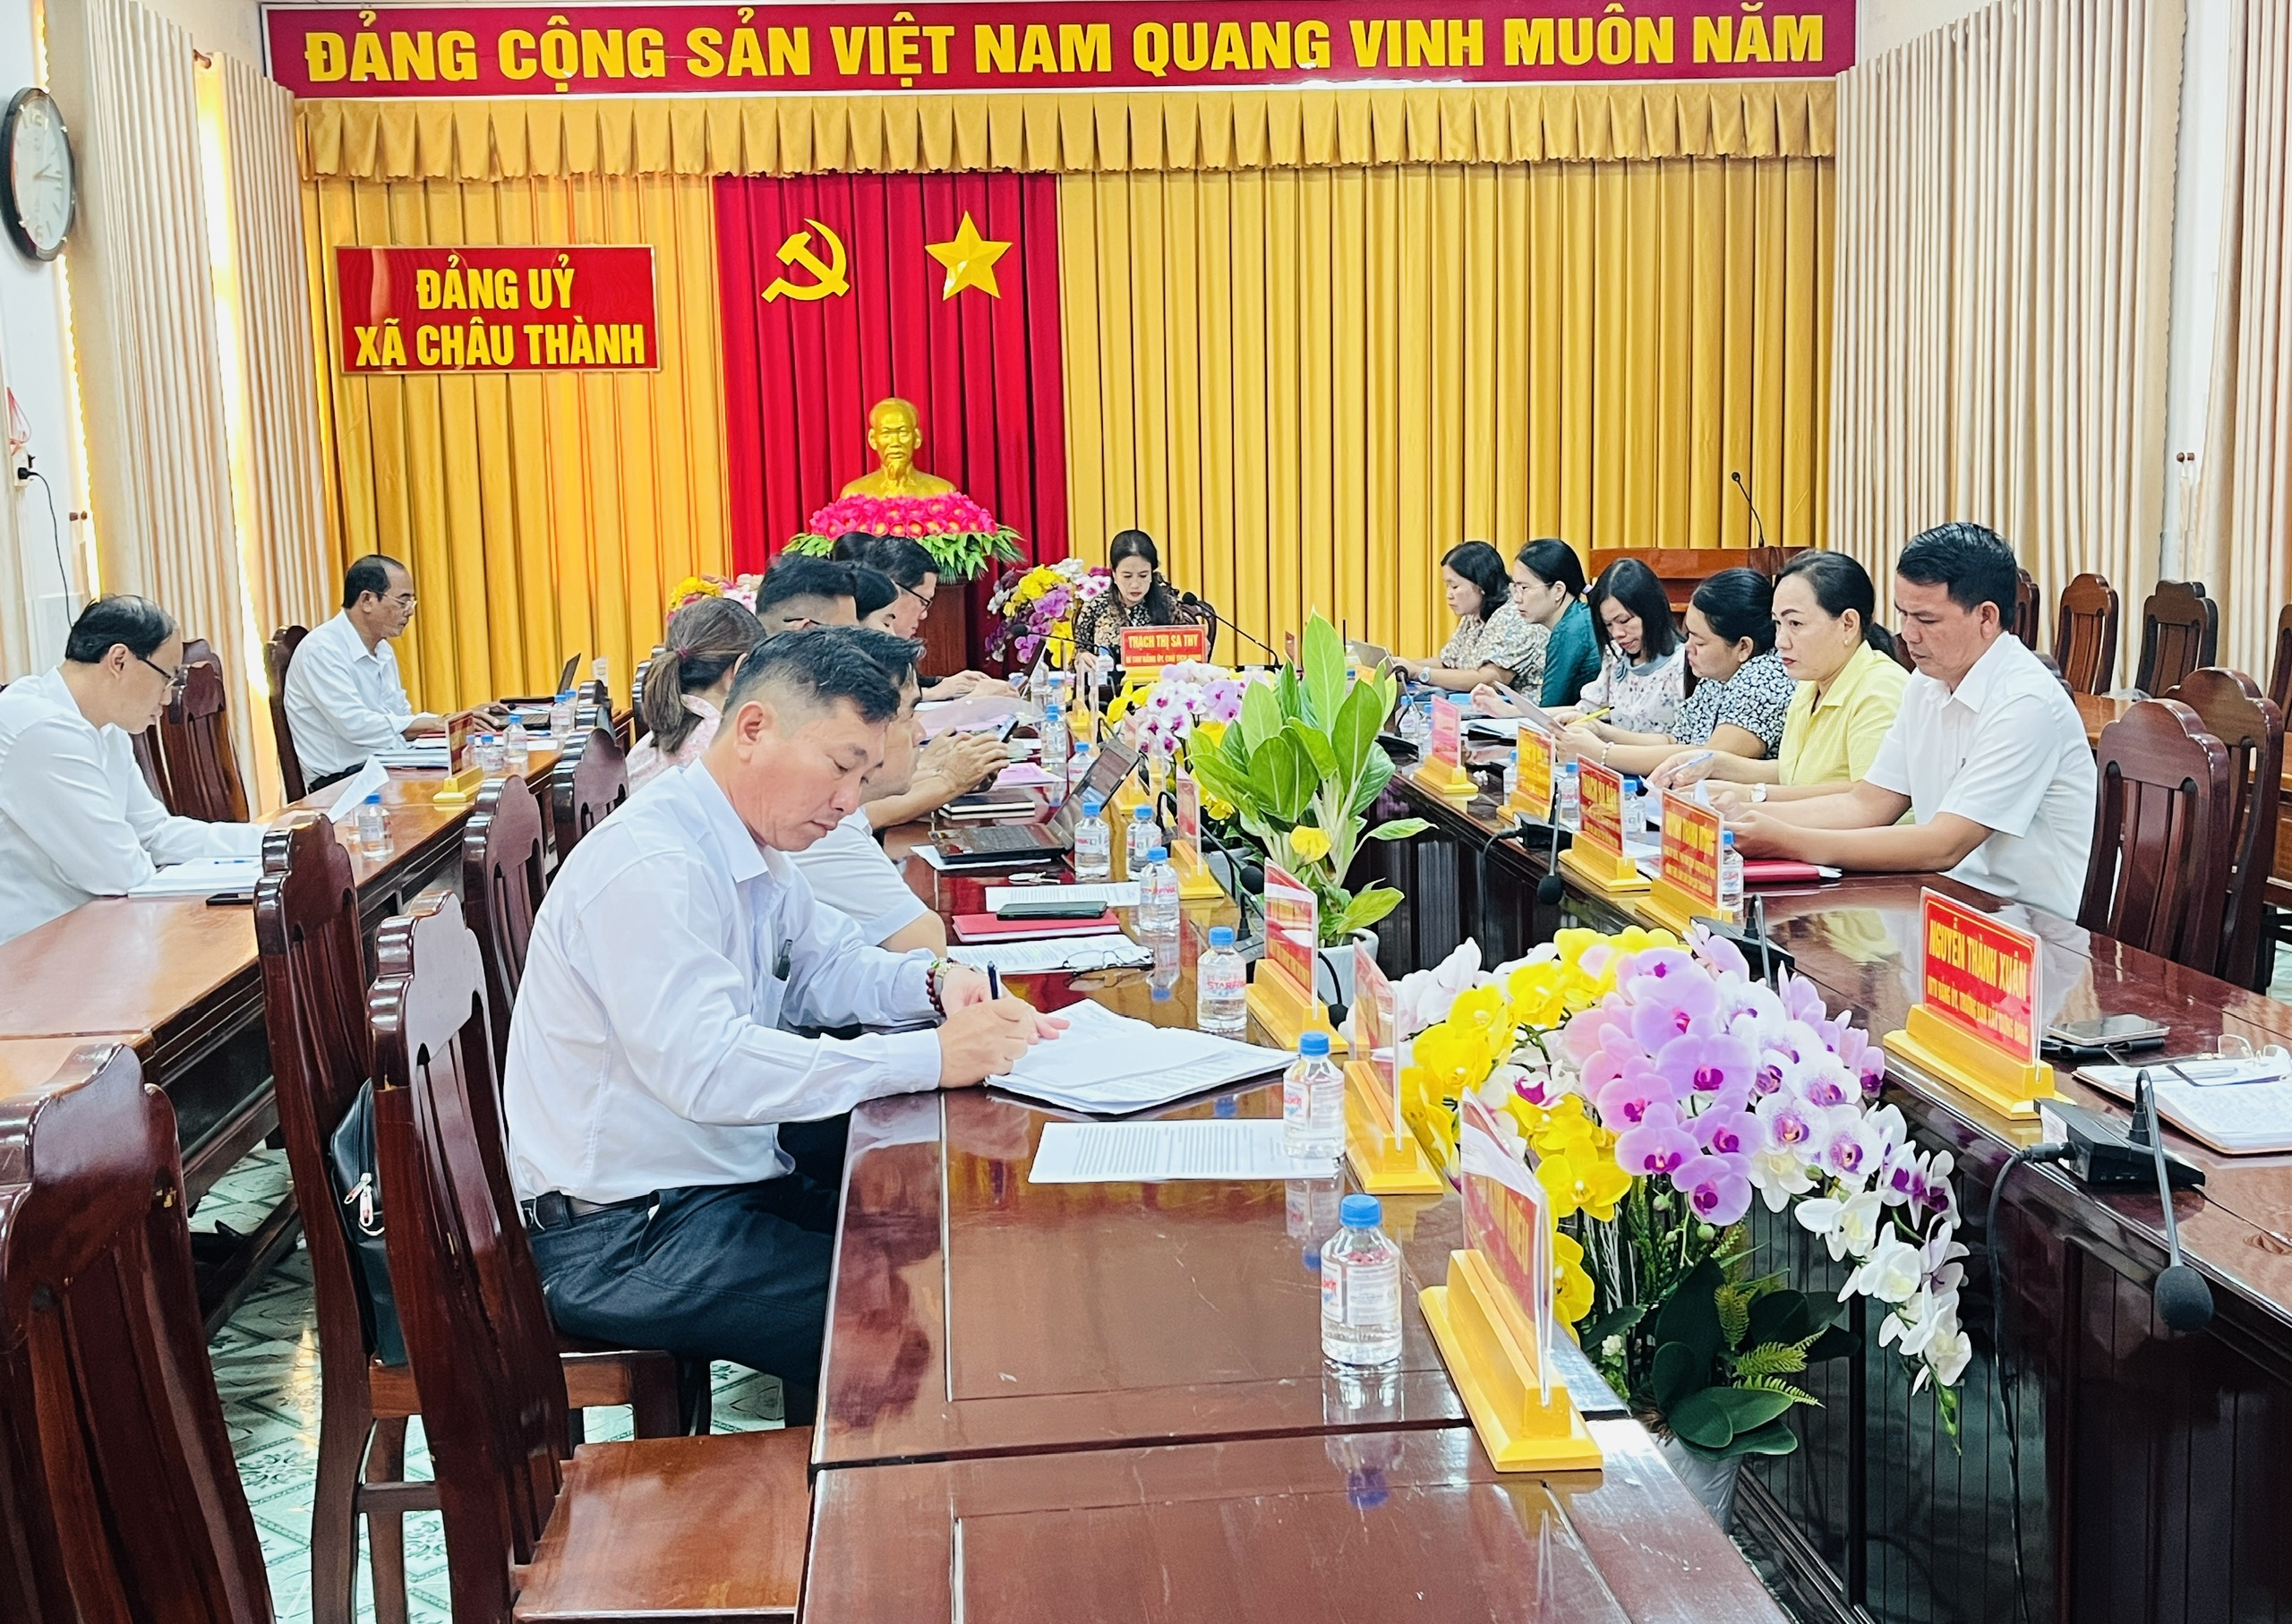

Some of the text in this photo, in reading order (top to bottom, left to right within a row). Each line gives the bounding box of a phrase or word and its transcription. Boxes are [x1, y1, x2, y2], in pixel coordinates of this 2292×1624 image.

[305, 2, 1824, 92] ĐẢNG CỘNG SẢN VIỆT NAM QUANG VINH MUÔN NĂM
[416, 253, 575, 310] ĐẢNG UỶ
[355, 315, 646, 366] XÃ CHÂU THÀNH
[1929, 918, 1966, 971] NGUYỄN
[1967, 934, 1997, 987] THÀNH
[1998, 951, 2028, 1000] XUÂN
